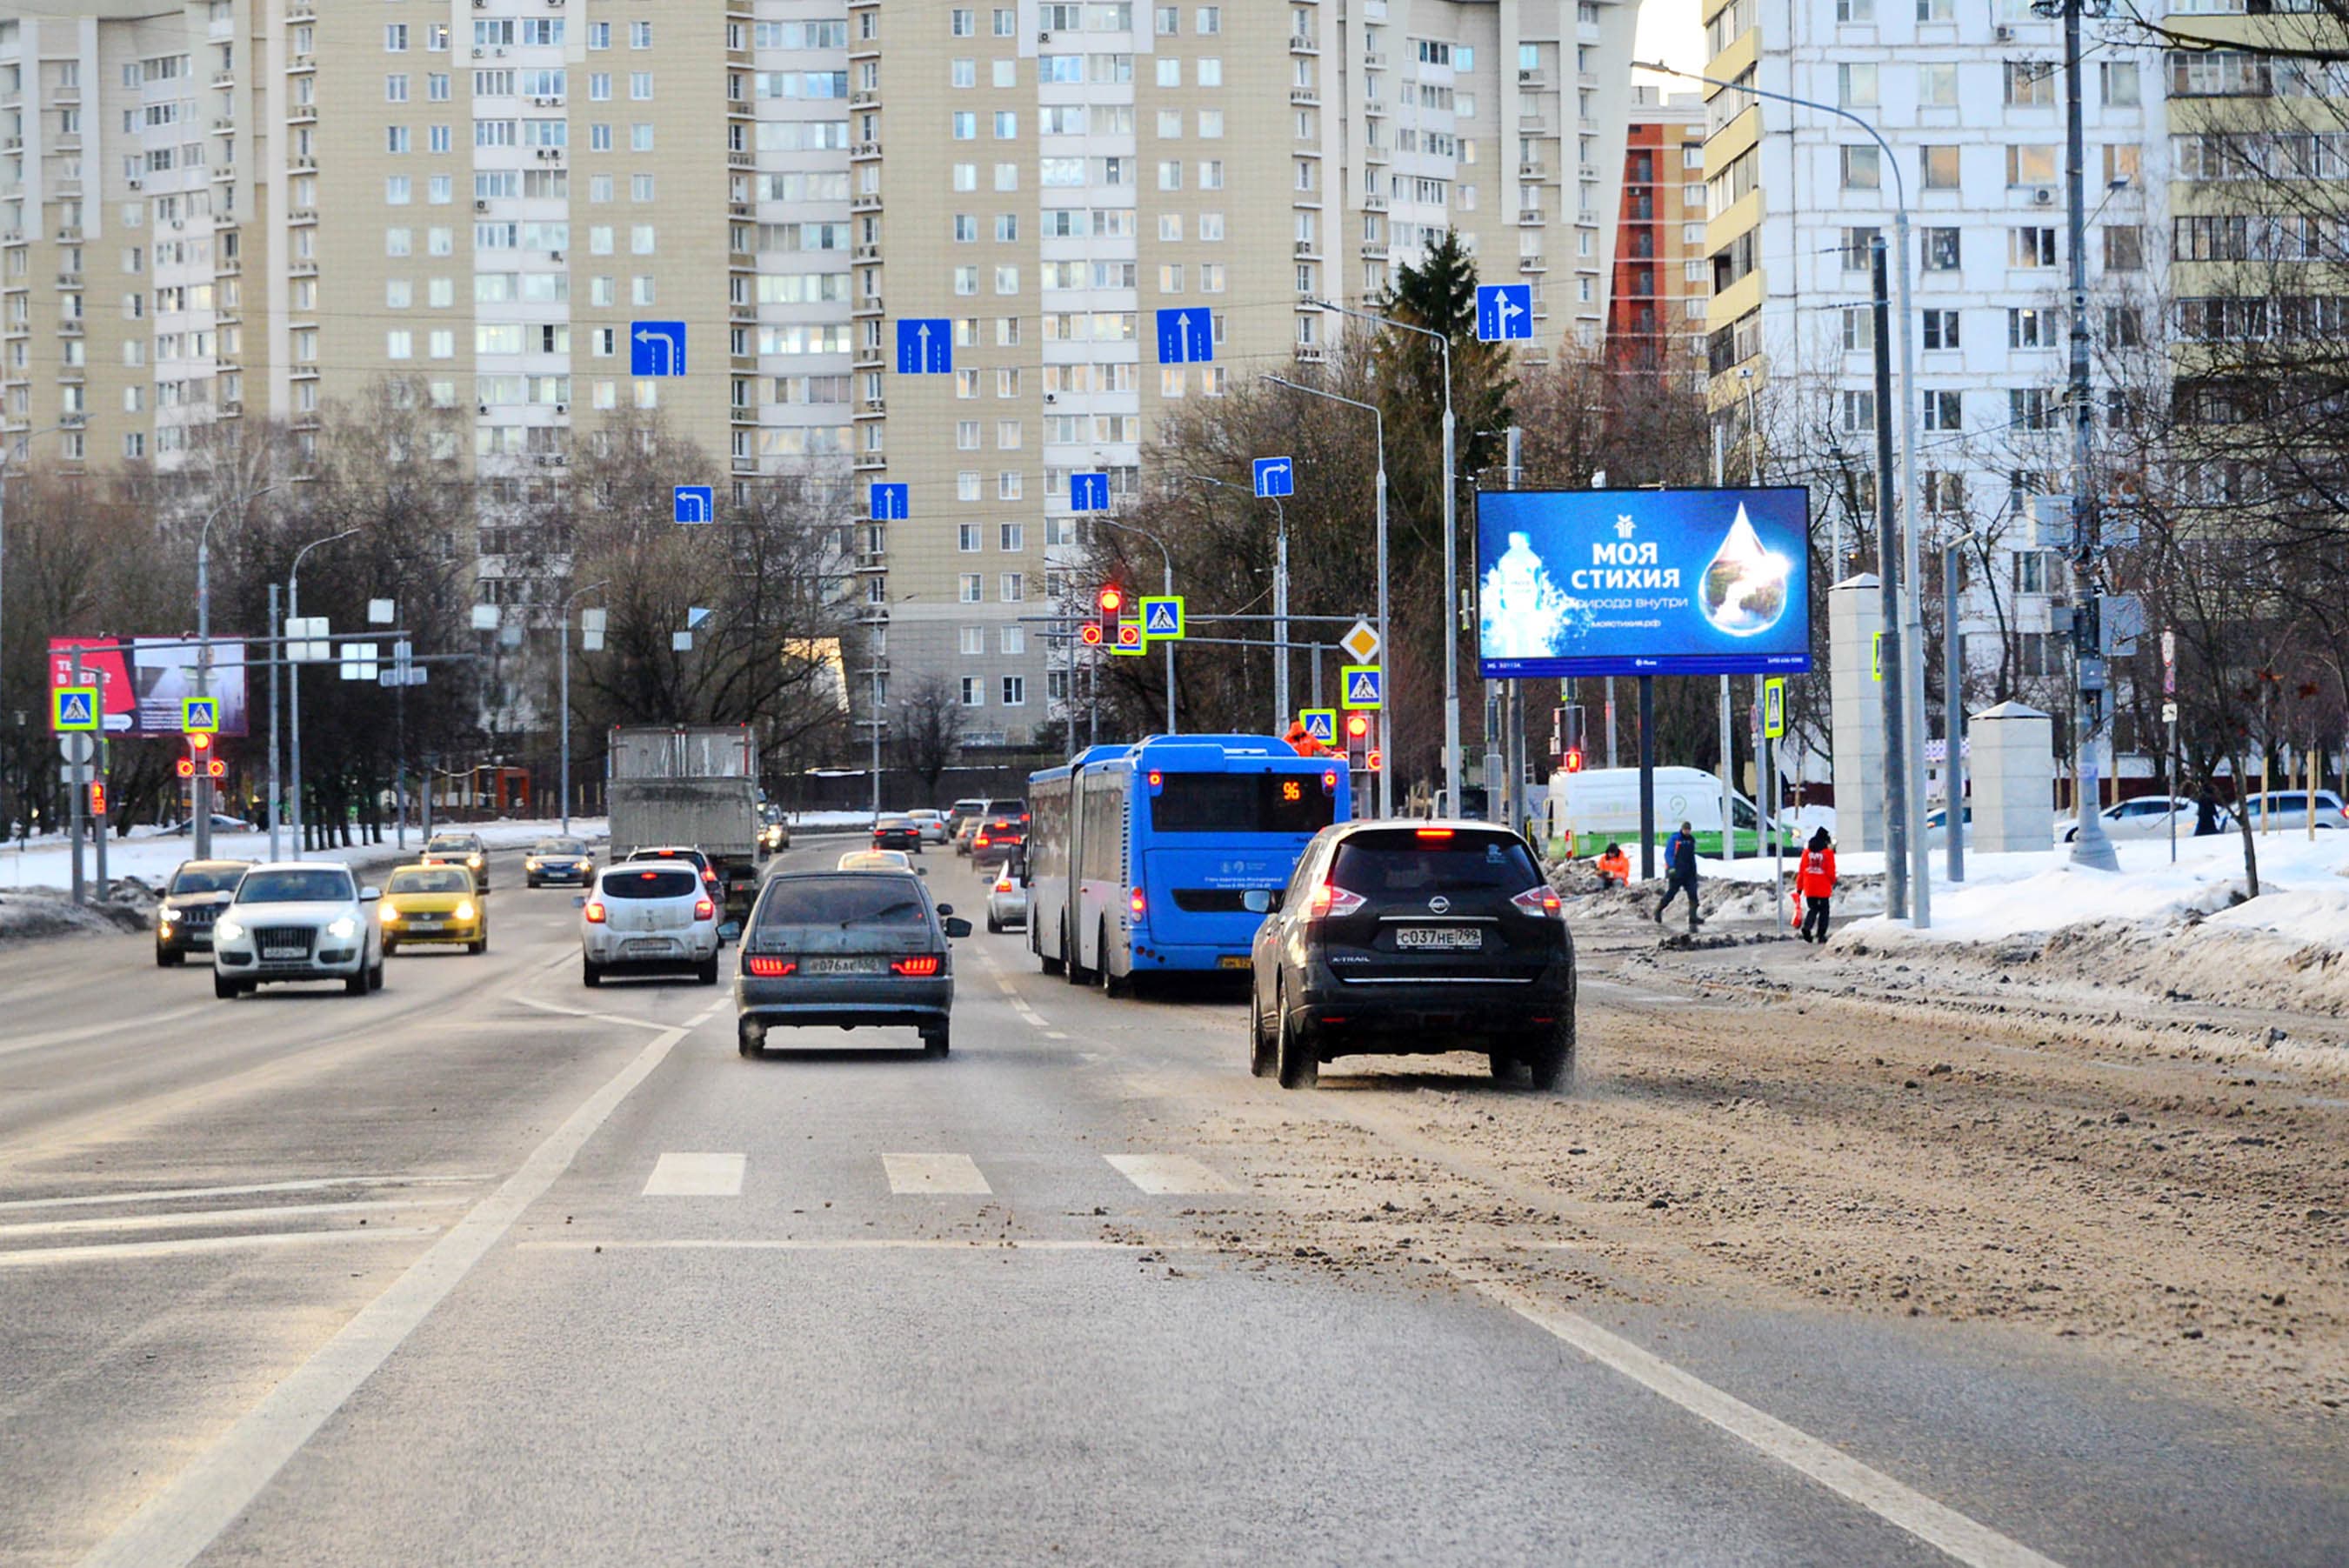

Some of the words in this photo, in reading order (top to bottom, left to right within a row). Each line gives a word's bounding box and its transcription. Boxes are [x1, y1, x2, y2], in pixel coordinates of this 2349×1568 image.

[1592, 542, 1658, 565] МОЯ
[1571, 568, 1680, 590] СТИХИЯ
[1635, 597, 1689, 611] внутри
[1283, 781, 1301, 800] 96
[1400, 930, 1454, 944] С037НЕ
[1458, 928, 1478, 941] 799
